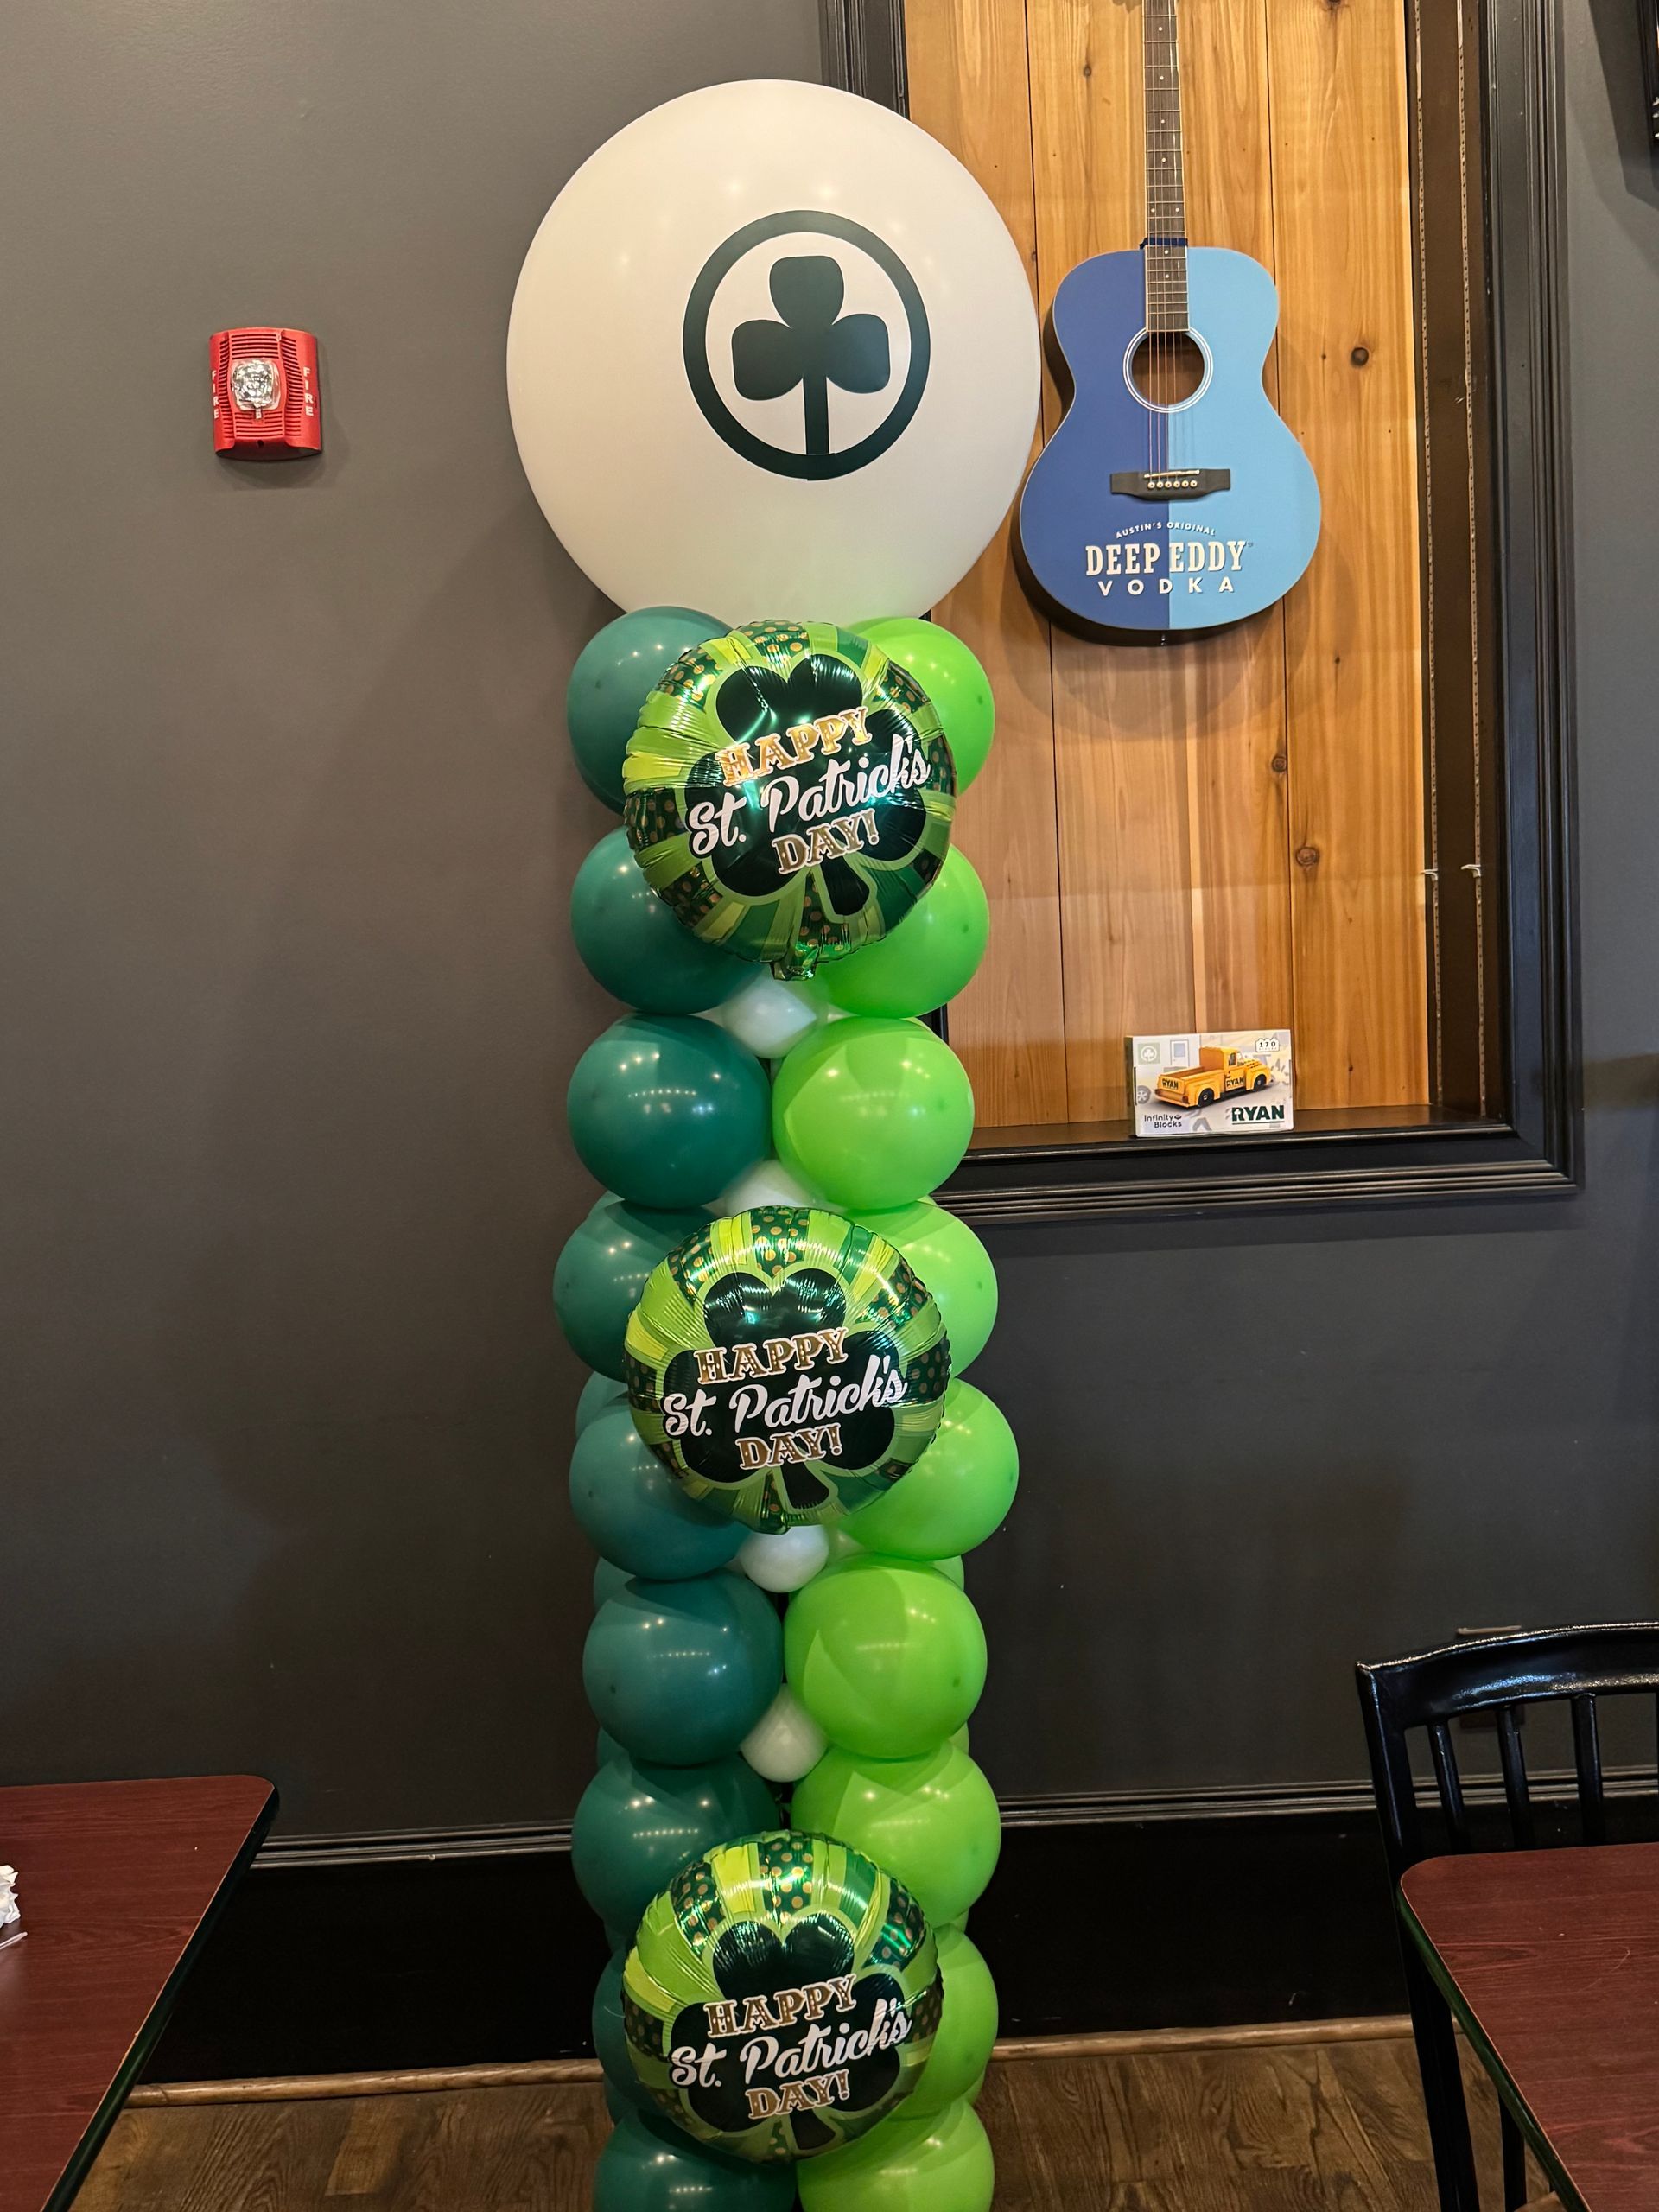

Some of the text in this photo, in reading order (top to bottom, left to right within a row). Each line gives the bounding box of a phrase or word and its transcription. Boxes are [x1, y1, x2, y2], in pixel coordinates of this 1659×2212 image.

[303, 367, 314, 416] FIRE
[1116, 521, 1216, 538] AUSTIN'S ORIGINAL
[1085, 541, 1246, 575] DEEP EDDY
[1098, 576, 1234, 596] VODKA
[715, 707, 871, 787] HAPPY
[689, 734, 931, 855] St. Patrick's
[772, 809, 879, 874] DAY!
[1161, 1078, 1179, 1090] RYAN
[1226, 1077, 1244, 1087] RYAN
[1231, 1105, 1284, 1122] RYAN
[694, 1327, 849, 1384] HAPPY
[663, 1354, 907, 1437] St. Patrick's
[735, 1423, 842, 1470] DAY!
[703, 1974, 857, 2038] HAPPY
[671, 1998, 912, 2088] St. Patrick's
[745, 2069, 850, 2120] DAY!
